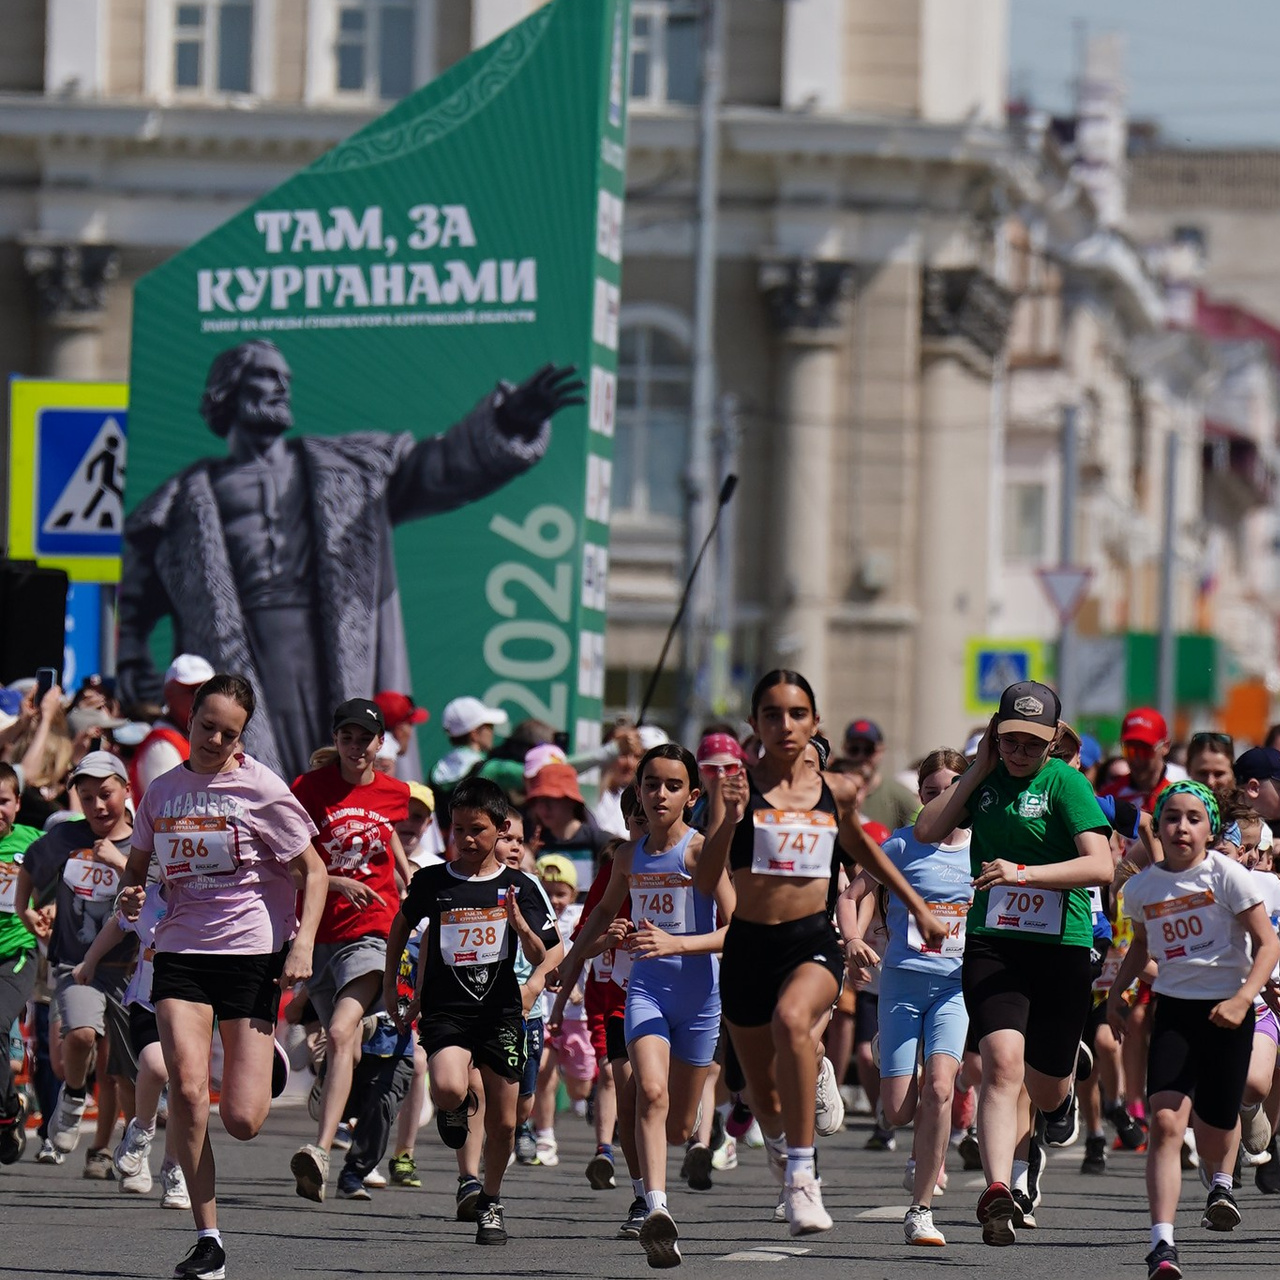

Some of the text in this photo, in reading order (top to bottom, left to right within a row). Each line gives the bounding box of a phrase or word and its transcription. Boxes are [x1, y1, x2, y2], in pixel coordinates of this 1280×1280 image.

[254, 203, 477, 258] ТАМ, ЗА
[197, 257, 537, 312] КУРГАНАМИ
[168, 838, 209, 859] 786
[777, 831, 820, 855] 747
[81, 866, 114, 887] 703
[638, 893, 675, 915] 748
[1006, 891, 1045, 914] 709
[458, 926, 497, 948] 738
[1162, 915, 1203, 943] 800
